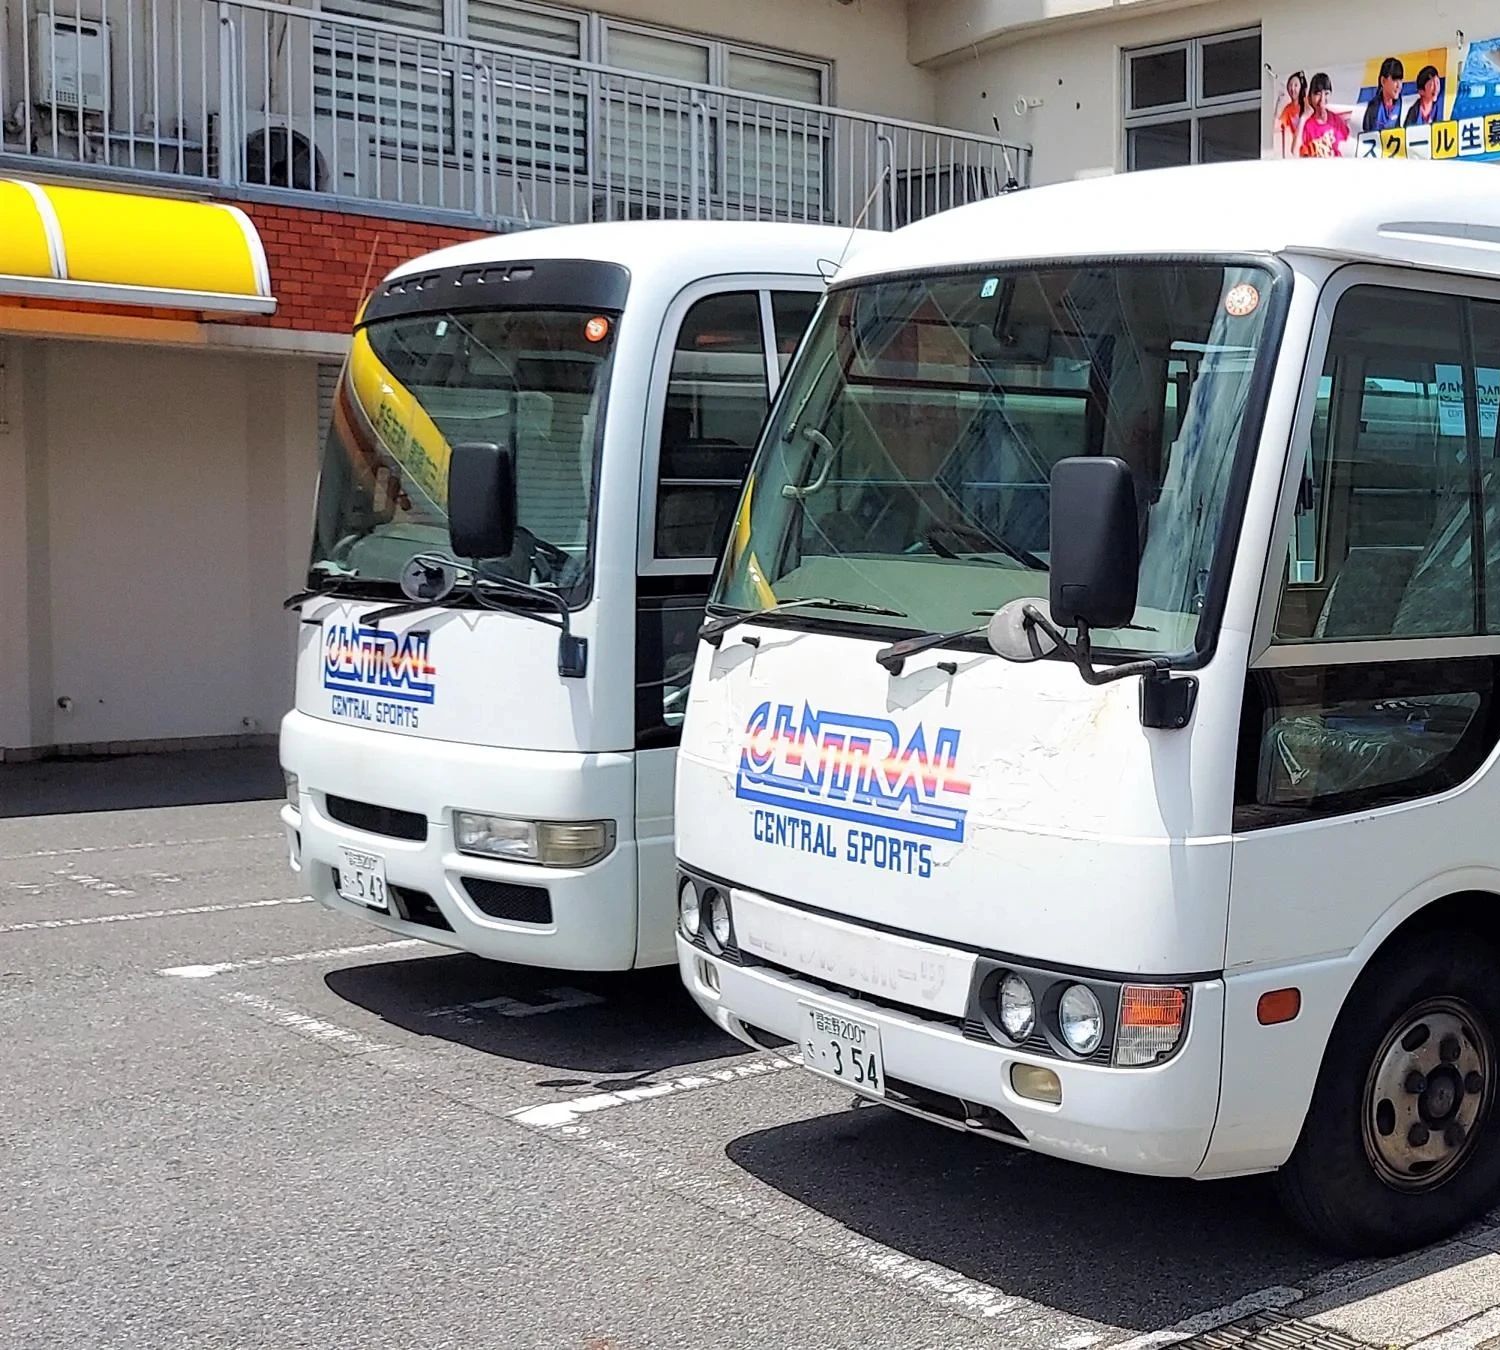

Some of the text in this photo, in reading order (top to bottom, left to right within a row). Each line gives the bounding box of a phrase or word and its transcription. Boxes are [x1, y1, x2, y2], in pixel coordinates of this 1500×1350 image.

[324, 622, 436, 704] CENTRAL
[332, 695, 419, 729] CENTRAL SPORTS
[736, 698, 971, 843] CENTRAL
[753, 809, 932, 879] CENTRAL SPORTS
